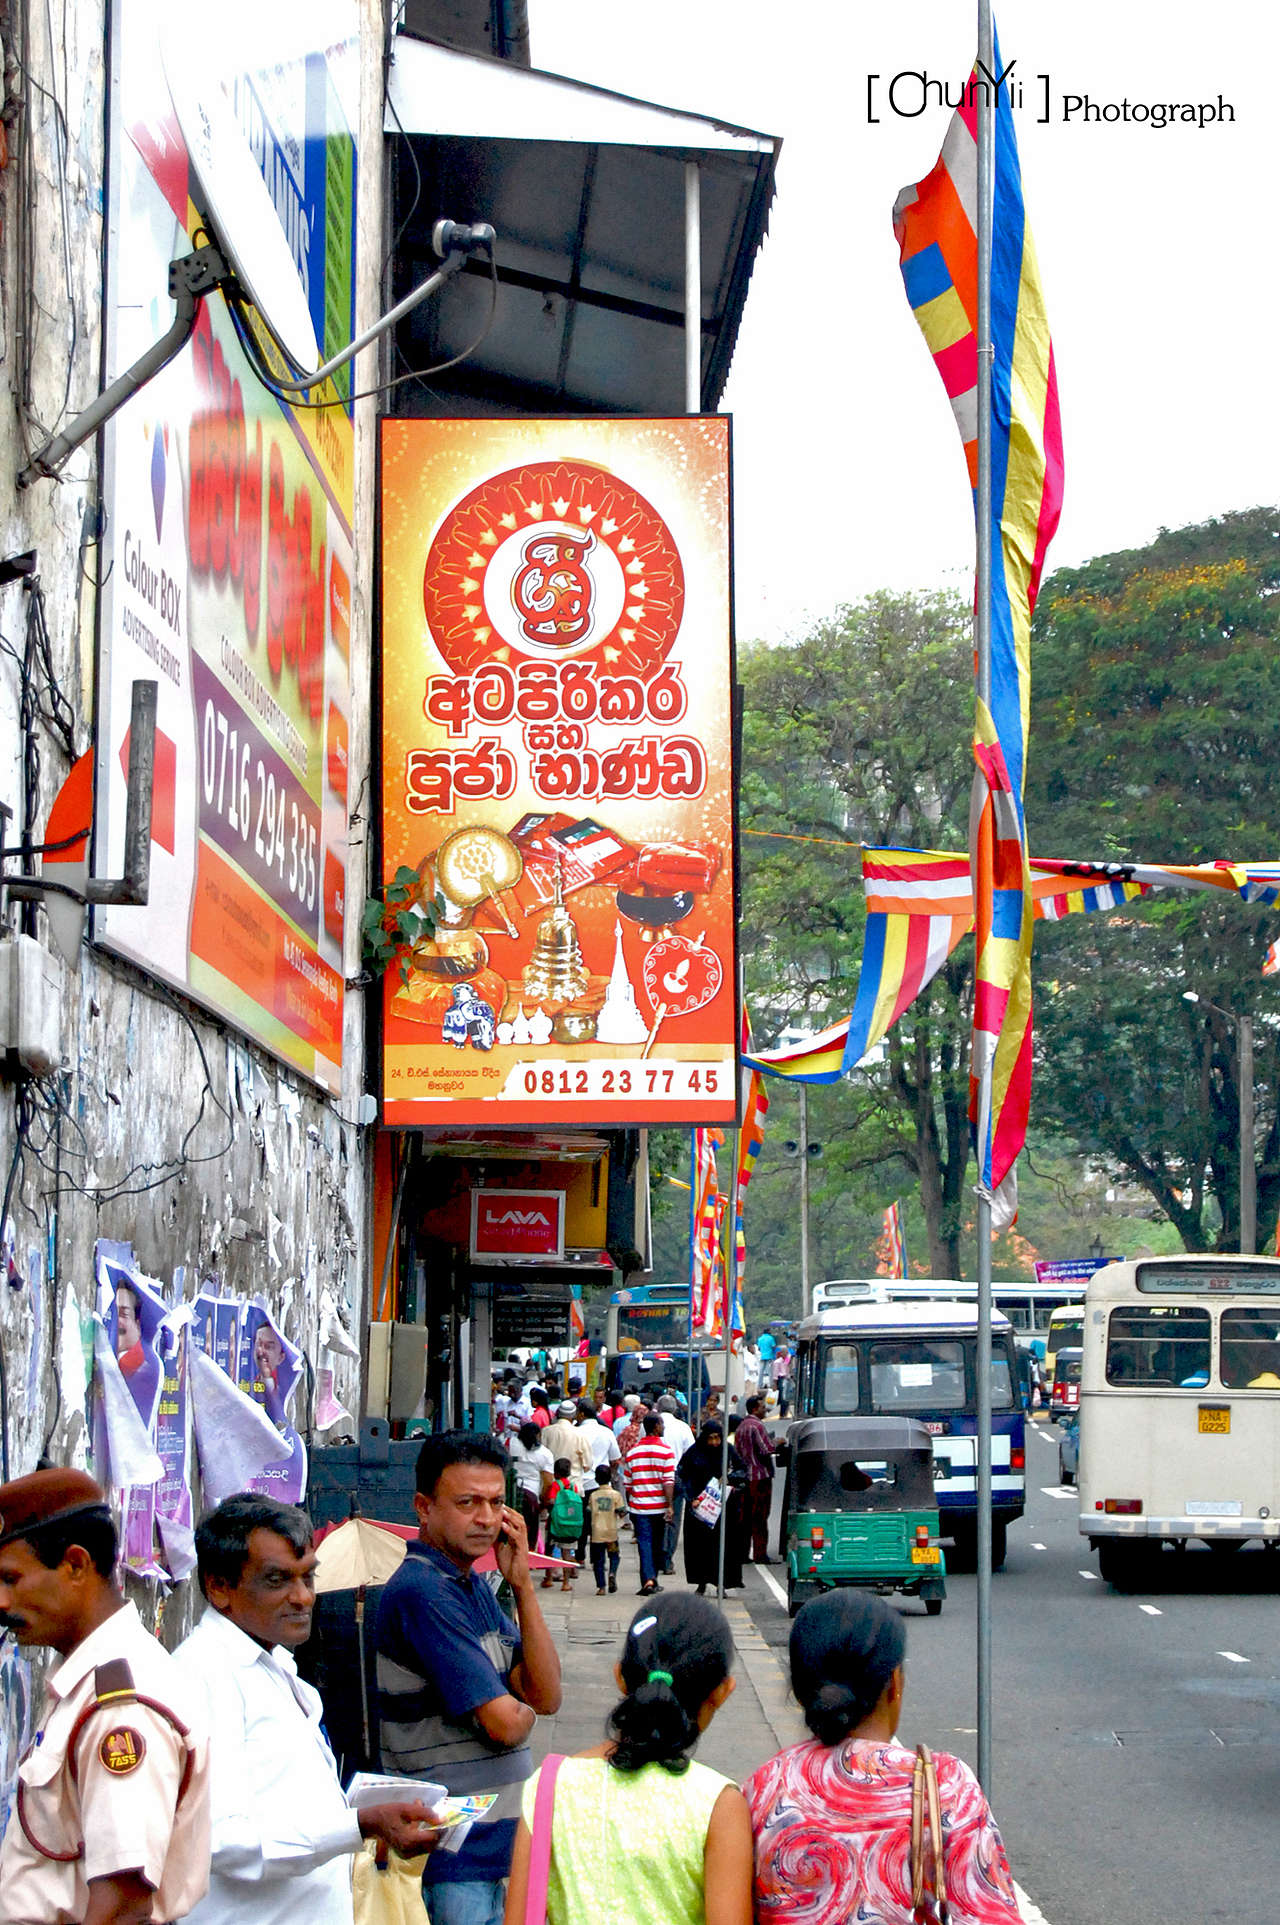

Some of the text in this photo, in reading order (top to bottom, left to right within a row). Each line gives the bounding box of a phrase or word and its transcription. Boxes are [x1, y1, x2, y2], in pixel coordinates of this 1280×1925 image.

[124, 529, 181, 637] Colour BOX
[122, 606, 181, 688] ADVERTISING SERVICE
[427, 663, 685, 735] අටපිරිකර
[527, 724, 584, 760] සහ
[409, 741, 513, 811] පූජා
[534, 738, 703, 797] භාණ්ඩ
[203, 698, 252, 842] 0716
[254, 759, 287, 879] 294
[289, 801, 317, 912] 335
[524, 1069, 719, 1093] 0812 23 77 45
[486, 1209, 550, 1226] LAVA
[1209, 1279, 1231, 1288] 622
[109, 1755, 137, 1768] TASS
